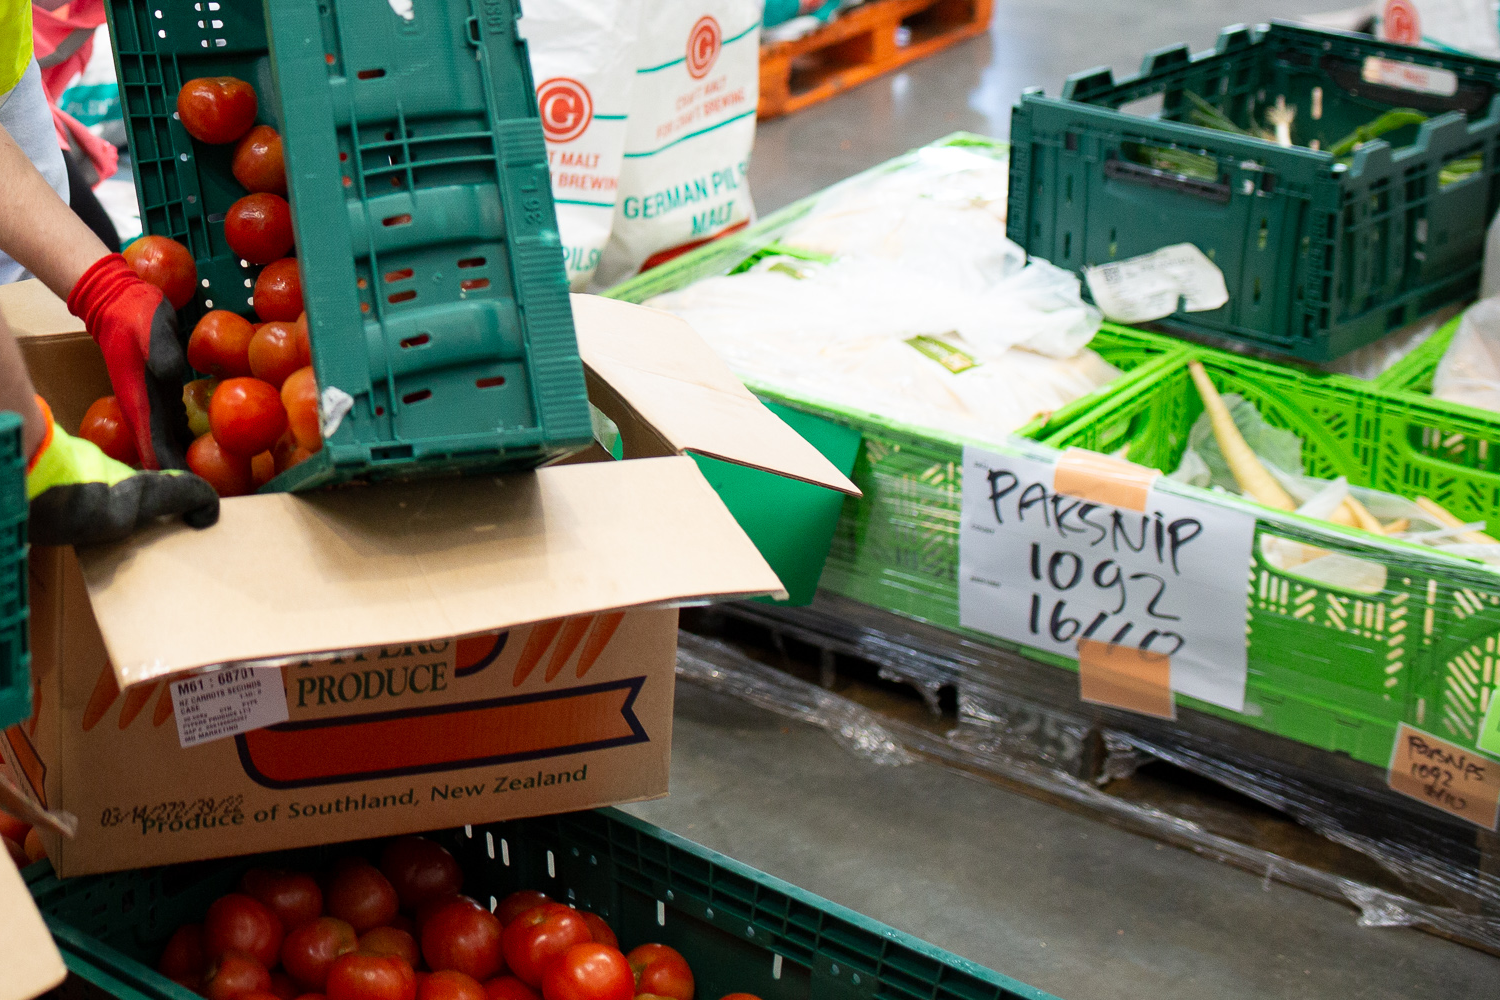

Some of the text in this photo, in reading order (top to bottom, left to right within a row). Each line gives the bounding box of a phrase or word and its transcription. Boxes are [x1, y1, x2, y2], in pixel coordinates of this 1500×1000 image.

[623, 173, 708, 219] GERMAN
[987, 469, 1202, 576] PARSNIP
[1030, 542, 1181, 621] 1092
[296, 661, 448, 707] PRODUCE
[141, 764, 588, 835] Produce of Southland, New Zealand
